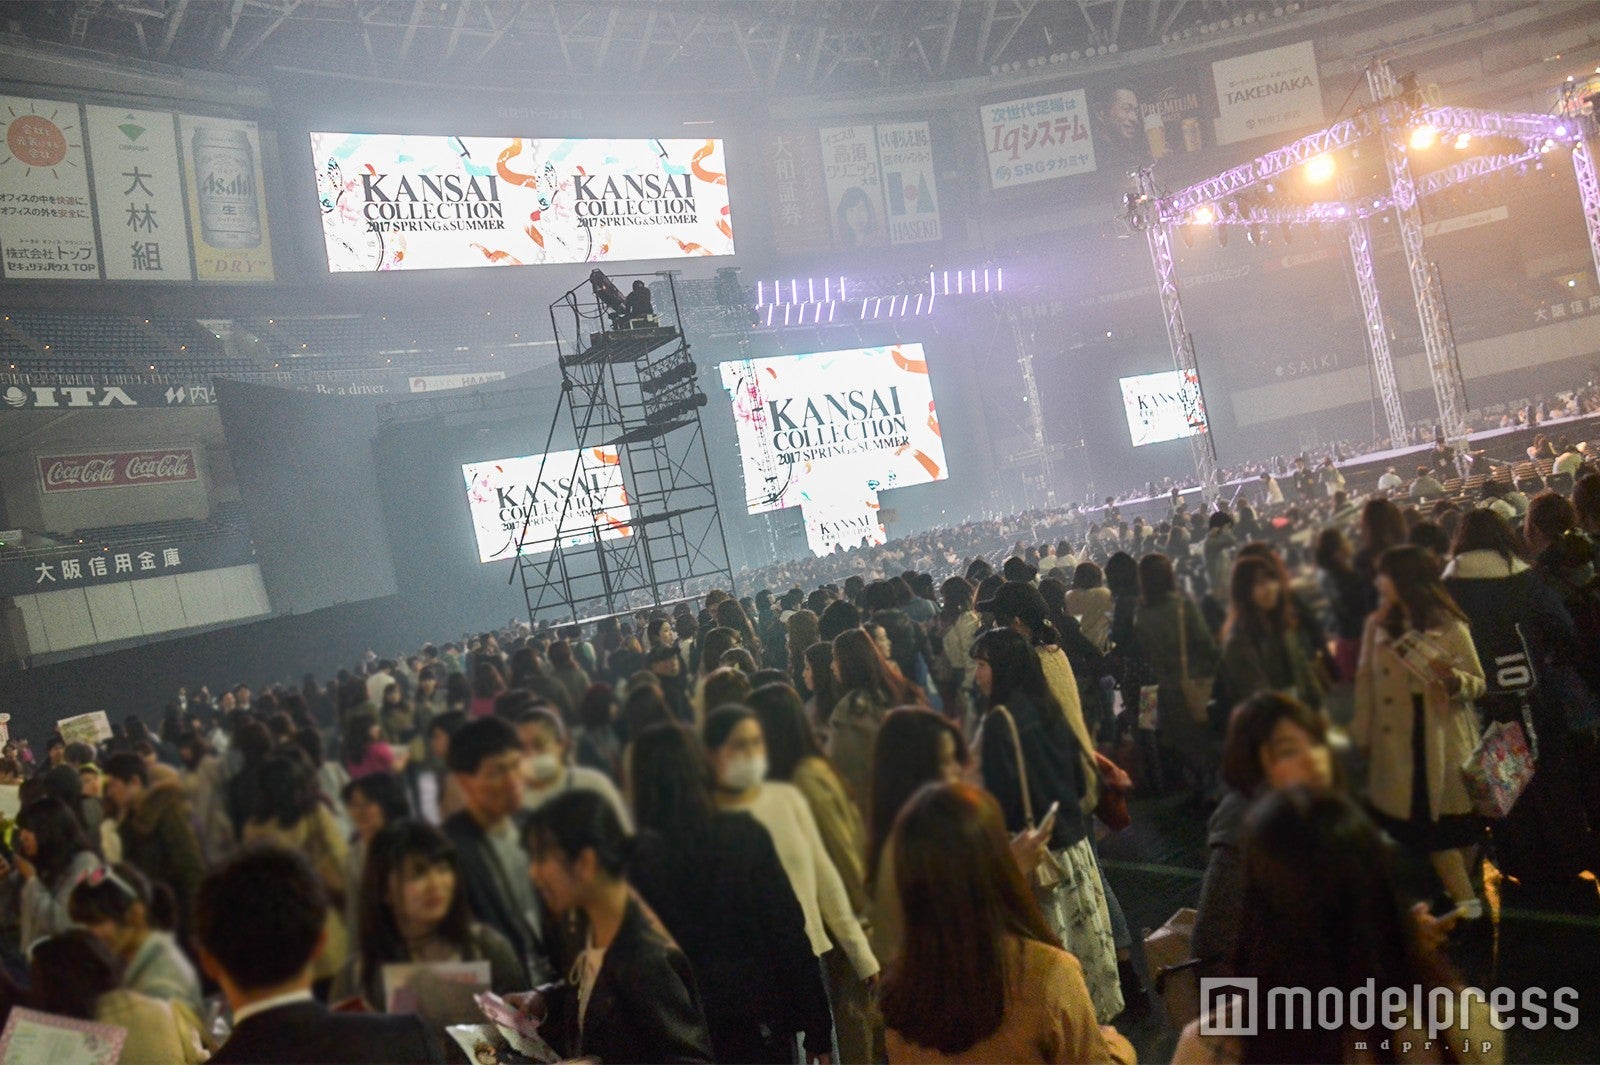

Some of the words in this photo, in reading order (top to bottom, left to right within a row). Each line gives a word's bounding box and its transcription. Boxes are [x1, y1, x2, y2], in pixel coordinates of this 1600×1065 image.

[1224, 75, 1314, 105] TAKENAKA
[991, 97, 1076, 122] 次世代足場は
[1139, 92, 1198, 118] PREMIUM
[990, 114, 1089, 161] Iqシステム
[826, 161, 877, 179] クリニック
[1014, 153, 1089, 177] SRGタカミヤ
[200, 171, 252, 197] Asahi
[358, 173, 501, 203] KANSAI
[571, 173, 694, 201] KANSAI
[774, 136, 802, 226] 大和証券
[1, 206, 90, 219] オフィスの外を安全に。
[121, 166, 164, 272] 大林組
[362, 202, 503, 221] COLLECTION
[574, 198, 697, 217] COLLECTION
[366, 220, 391, 233] 2017
[393, 219, 506, 232] SPRING&SUMMER
[577, 215, 599, 228] 2017
[600, 214, 699, 227] SPRING&SUMMER
[891, 219, 938, 241] HASEKO
[5, 247, 55, 260] 株式会社
[57, 245, 94, 260] トップ
[8, 262, 70, 272] セキュリティハウス
[72, 263, 96, 272] TOP
[1289, 353, 1339, 376] SAIKI
[348, 382, 389, 396] driver.
[768, 385, 903, 432] KANSAI
[773, 416, 907, 452] COLLECTION
[47, 457, 116, 485] Coca-Cola
[125, 454, 190, 480] Coca-Cola
[776, 451, 802, 466] 2017
[496, 473, 600, 508] KANSAI
[35, 547, 182, 584] 大阪信用金庫
